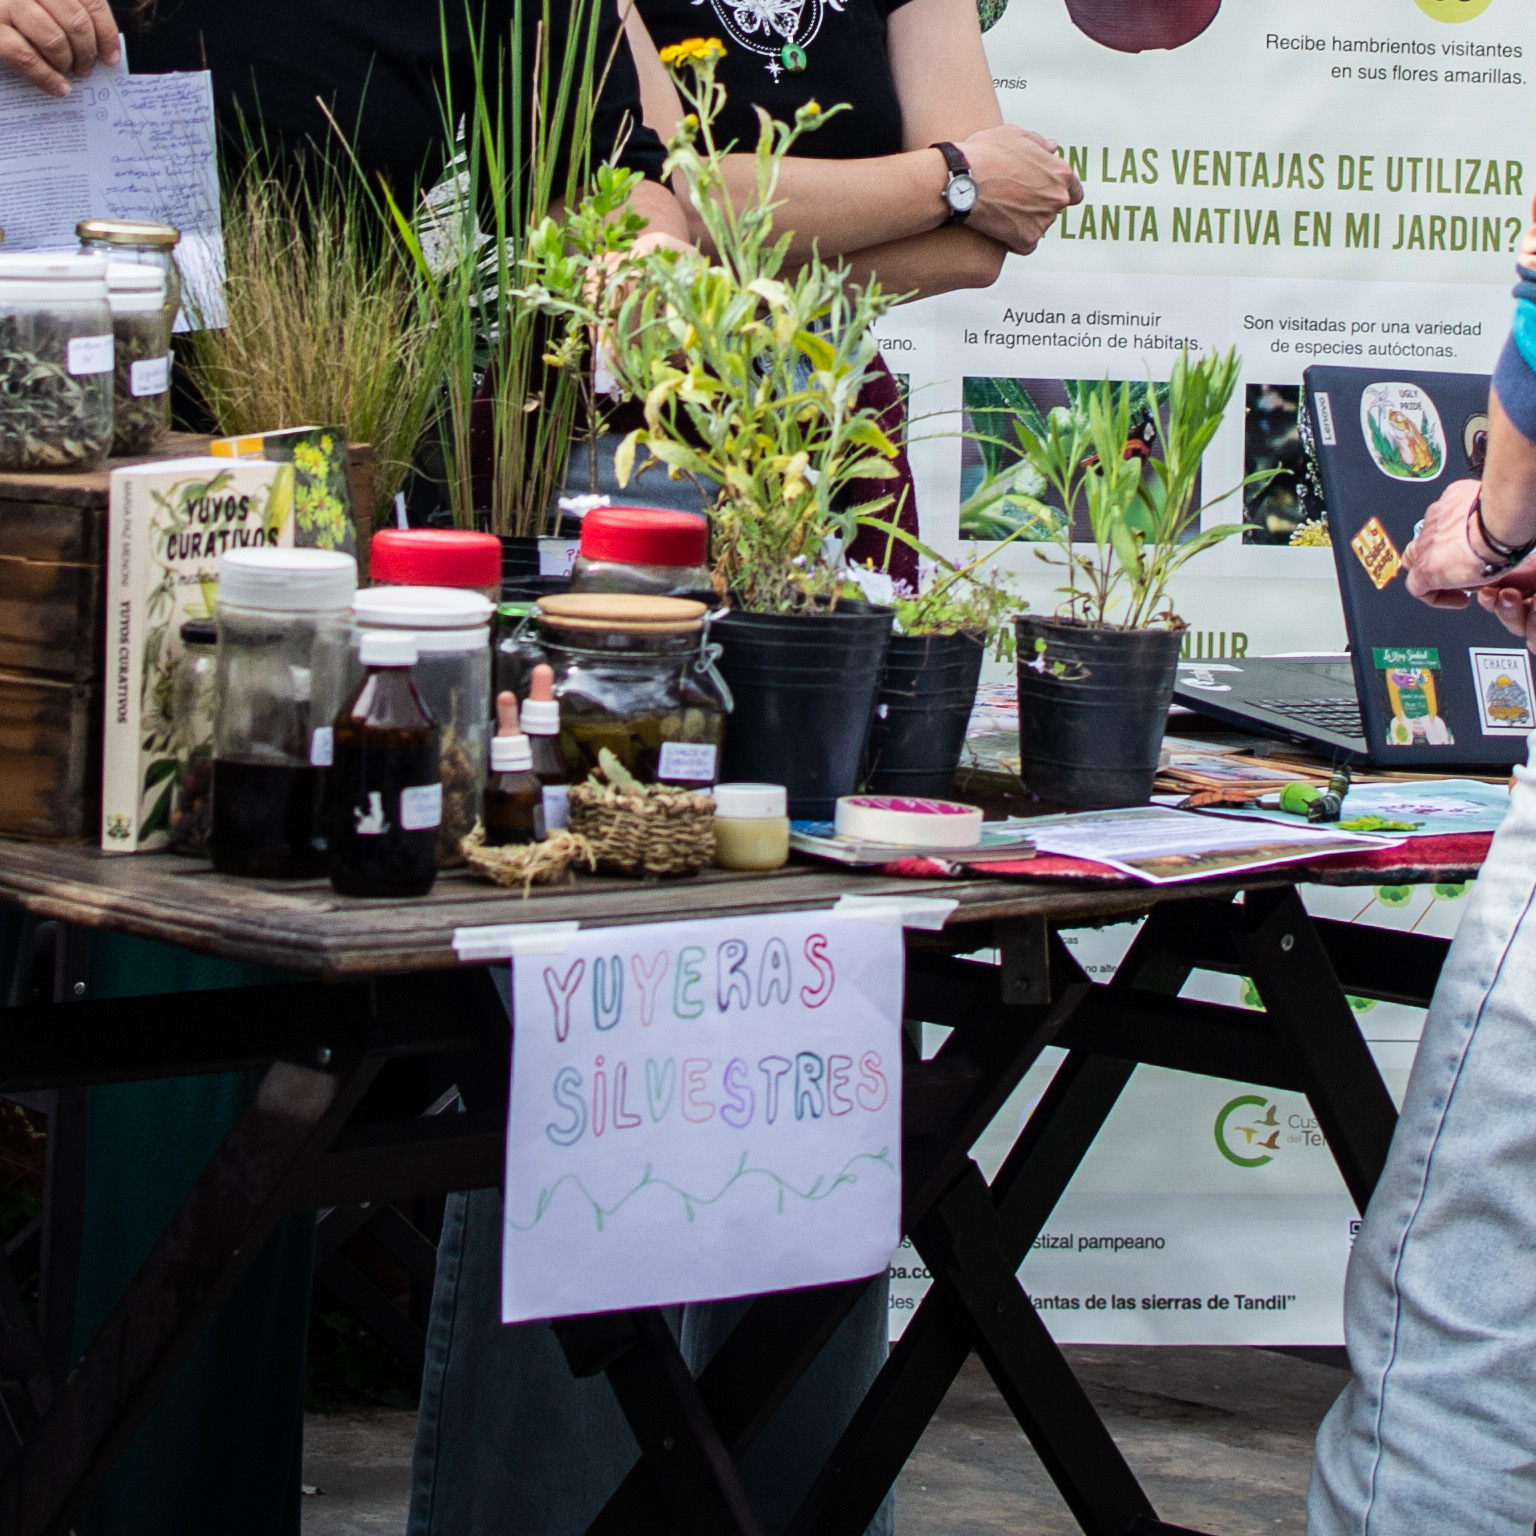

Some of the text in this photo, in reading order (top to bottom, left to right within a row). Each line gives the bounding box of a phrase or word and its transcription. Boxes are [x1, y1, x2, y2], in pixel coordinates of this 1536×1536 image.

[1266, 34, 1523, 58] Recibe hambrientos visitantes
[1331, 65, 1526, 85] en sus flores amarillas.
[1101, 147, 1159, 185] LAS
[1171, 149, 1324, 191] VENTAJAS
[1337, 154, 1374, 193] DE
[1386, 155, 1524, 196] UTILIZAR
[1046, 204, 1523, 253] LANTA NATIVA EN MI JARDIN?
[1003, 308, 1162, 327] Ayudan a disminuir
[1243, 315, 1482, 336] Son visitadas por una variedad
[964, 329, 1203, 352] la fragmentación de hábitats.
[1270, 339, 1458, 358] de especies autóctonas.
[1399, 389, 1418, 399] UGLY
[1400, 402, 1423, 411] PRIDE
[186, 495, 250, 525] YUYOS
[166, 526, 279, 561] CURATIVOS
[117, 601, 131, 724] YUYOS CURATIVOS
[1482, 658, 1519, 670] CHACRA
[543, 933, 836, 1042] YUYERAS
[1078, 1235, 1165, 1253] pampeano
[1085, 1294, 1107, 1311] de
[1111, 1294, 1136, 1311] las
[1141, 1294, 1203, 1311] sierras
[1207, 1294, 1230, 1311] de
